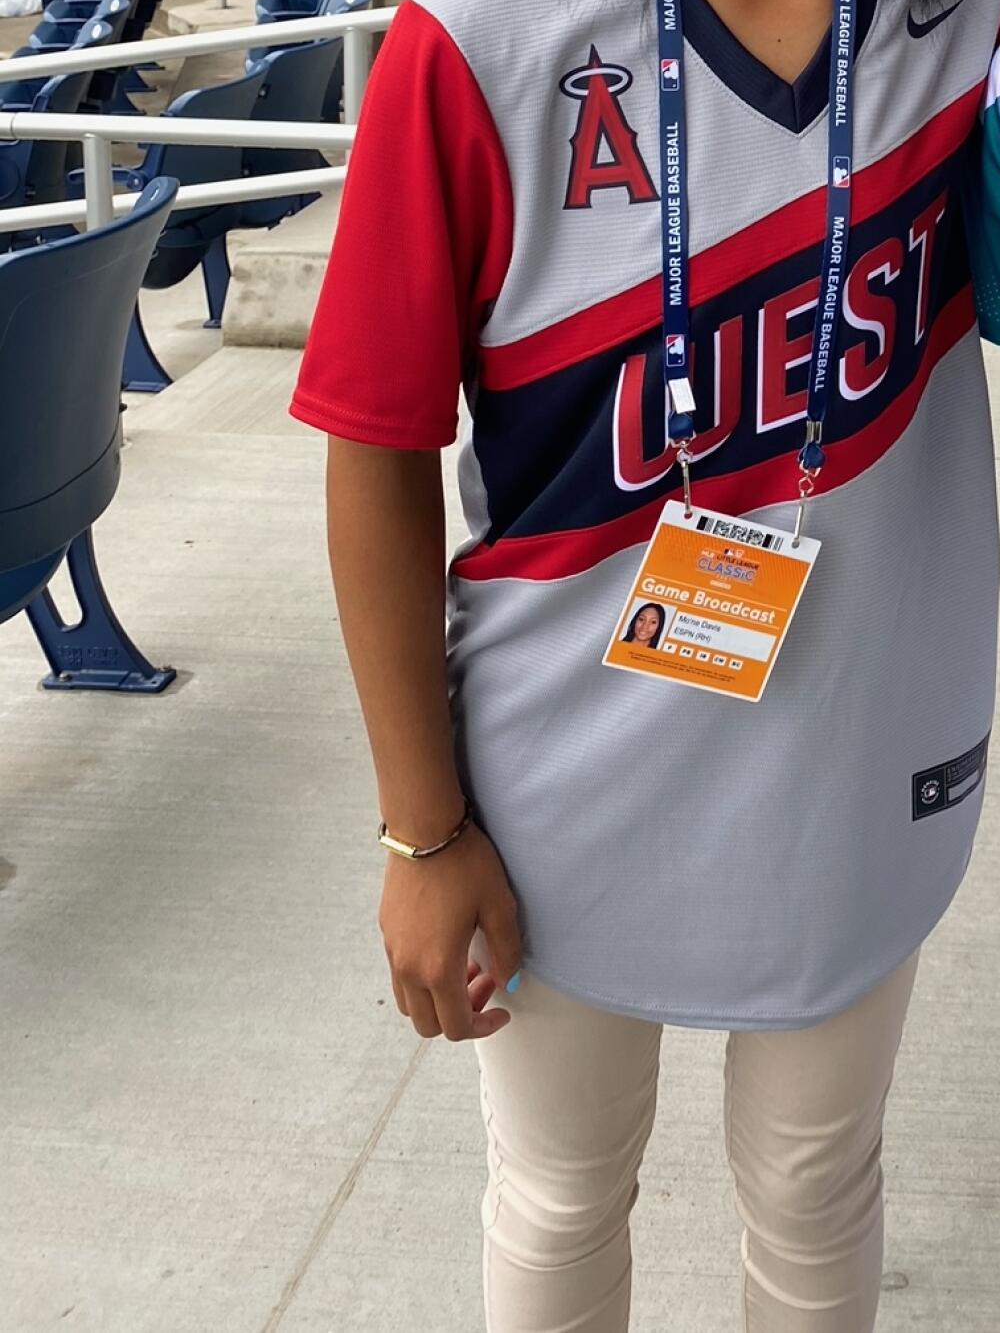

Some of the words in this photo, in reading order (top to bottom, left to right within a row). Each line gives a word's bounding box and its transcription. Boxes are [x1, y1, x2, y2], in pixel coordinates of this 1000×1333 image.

[838, 5, 851, 56] LEAGUE
[835, 60, 849, 126] BASEBALL
[563, 43, 661, 210] A
[667, 122, 680, 194] BASEBALL
[668, 198, 681, 253] LEAGUE
[830, 216, 845, 264] MAJOR
[669, 257, 681, 306] MAJOR
[823, 267, 840, 320] LEAGUE
[612, 186, 948, 492] WEST
[814, 323, 833, 393] BASEBALL
[640, 578, 690, 602] Game
[692, 590, 776, 624] Broadcast
[701, 620, 721, 632] Davis
[674, 626, 694, 638] ESPN
